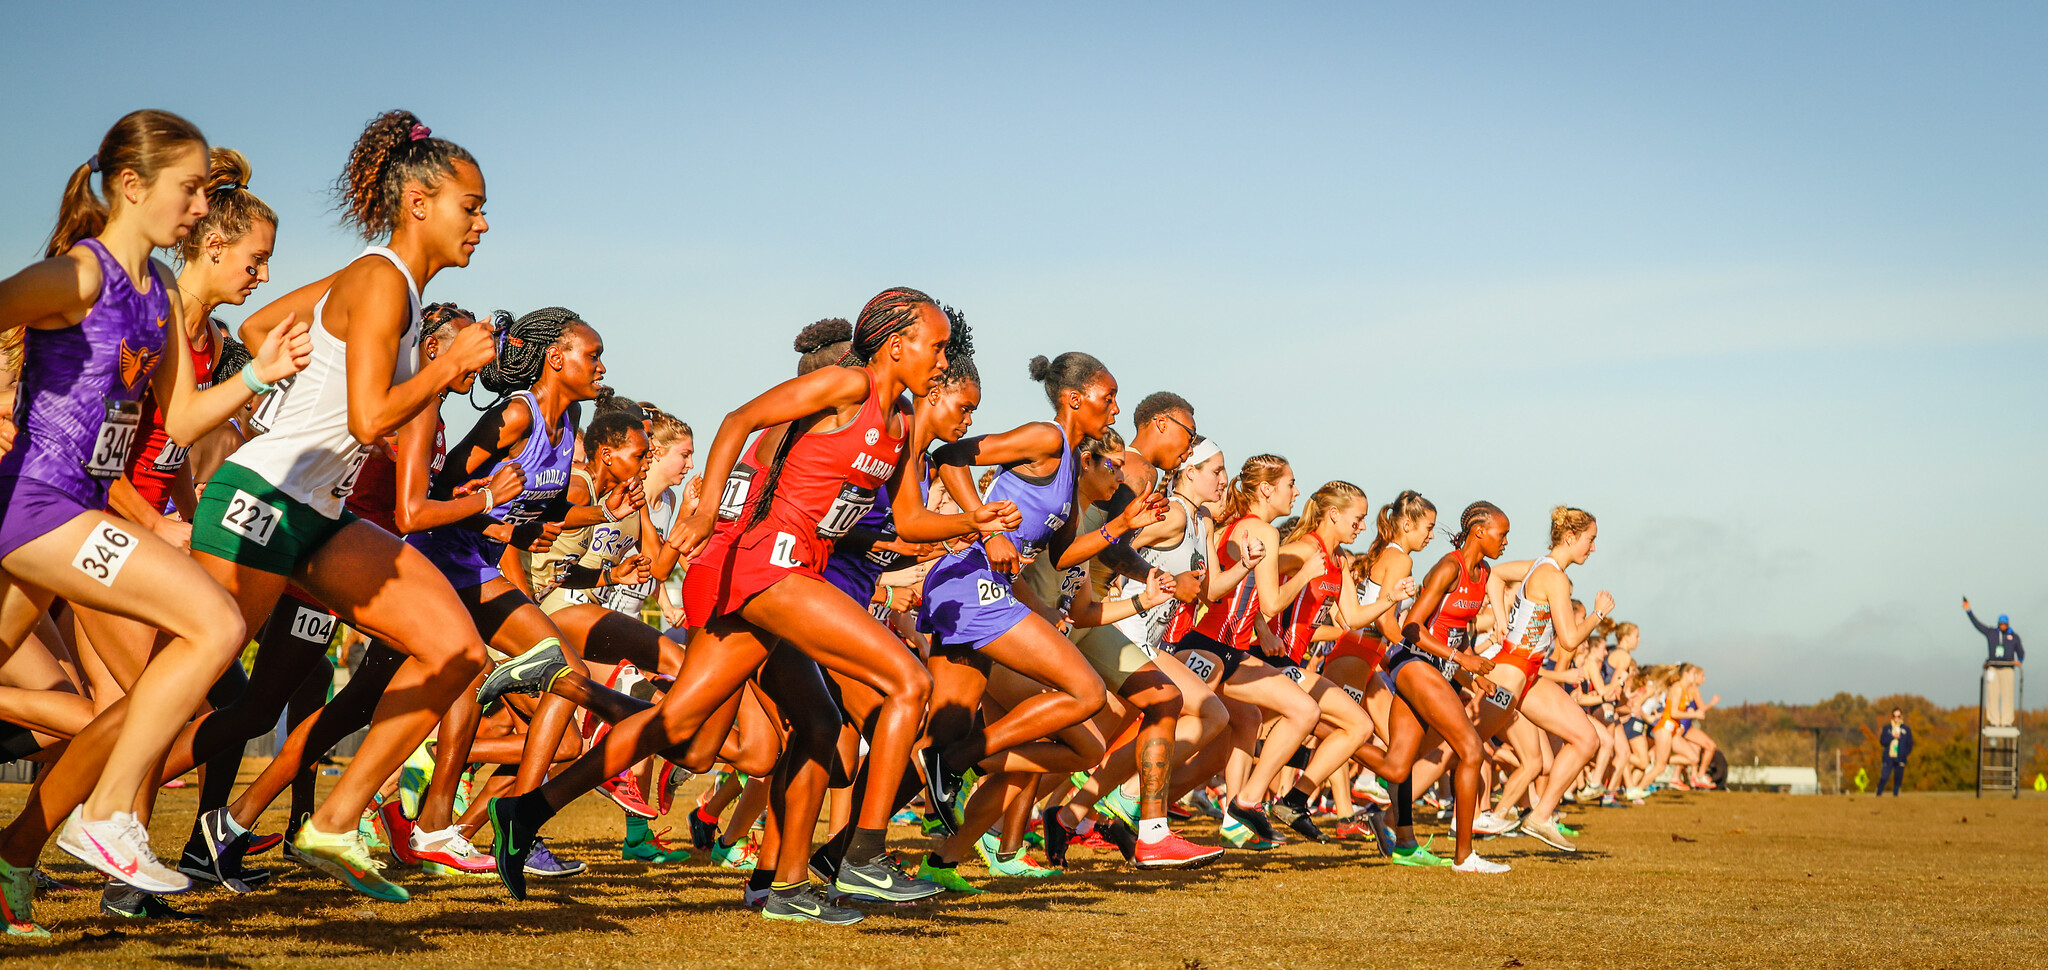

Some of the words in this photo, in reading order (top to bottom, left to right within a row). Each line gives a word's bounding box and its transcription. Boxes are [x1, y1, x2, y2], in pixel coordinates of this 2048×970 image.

[535, 469, 567, 489] MIDDLE
[226, 498, 274, 538] 221
[82, 528, 129, 579] 346
[297, 613, 332, 640] 104
[1190, 656, 1212, 679] 126
[1489, 690, 1511, 706] 63
